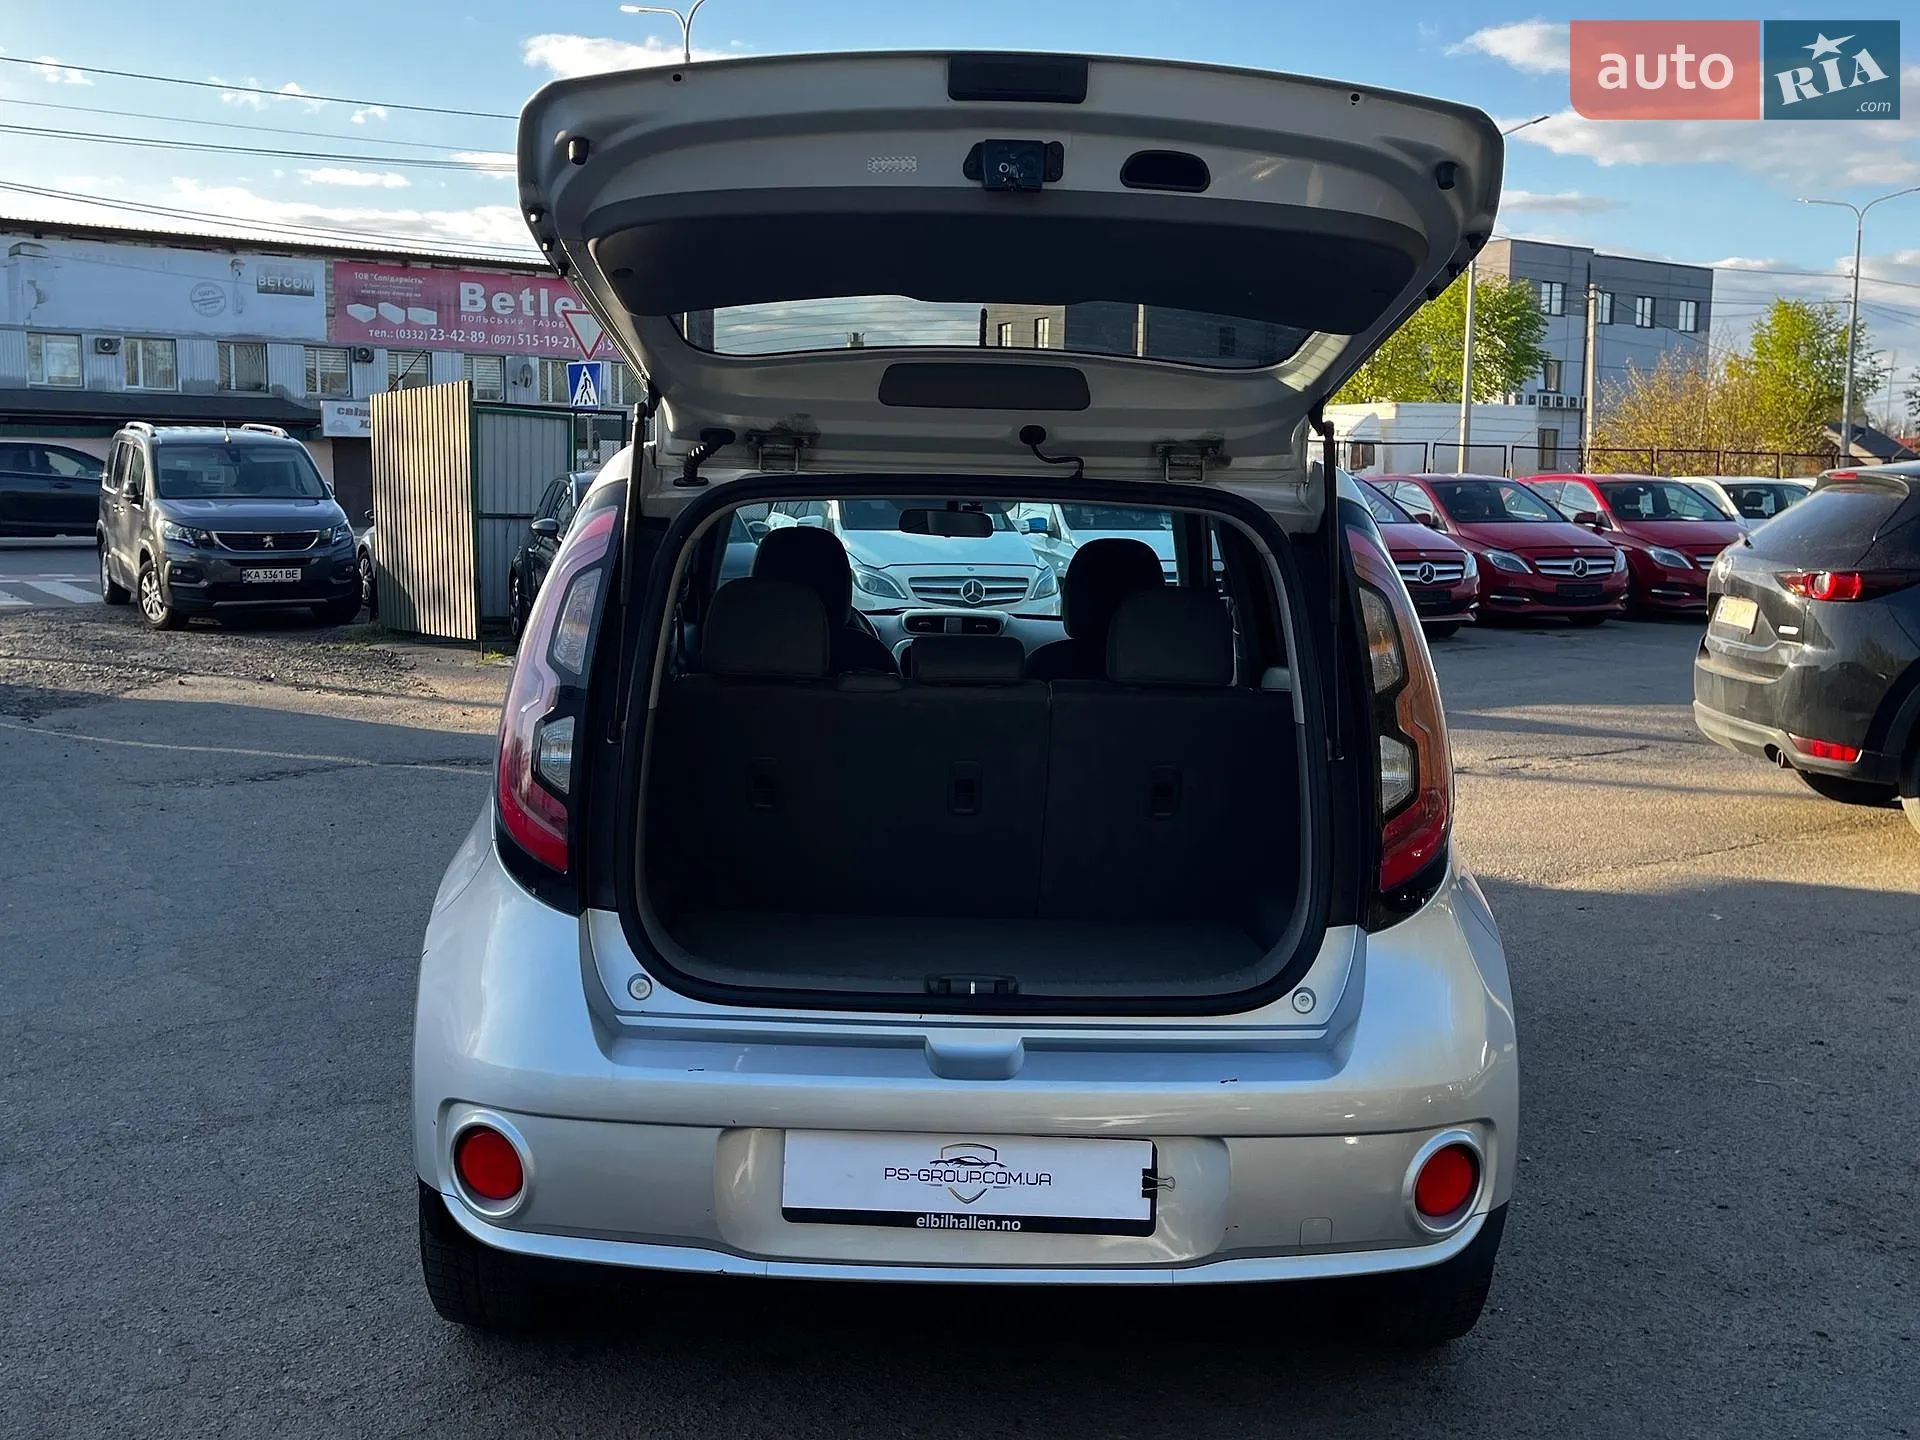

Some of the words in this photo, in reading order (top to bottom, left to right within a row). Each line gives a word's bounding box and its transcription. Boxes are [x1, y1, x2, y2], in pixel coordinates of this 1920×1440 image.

[258, 275, 313, 289] BETCOM
[459, 282, 588, 317] Betle
[395, 328, 428, 341] (0332)
[490, 334, 515, 346] (097)
[246, 570, 260, 579] KA
[263, 570, 283, 579] 3361
[285, 570, 299, 579] BE
[915, 1215, 1021, 1232] elbilhallen.no
